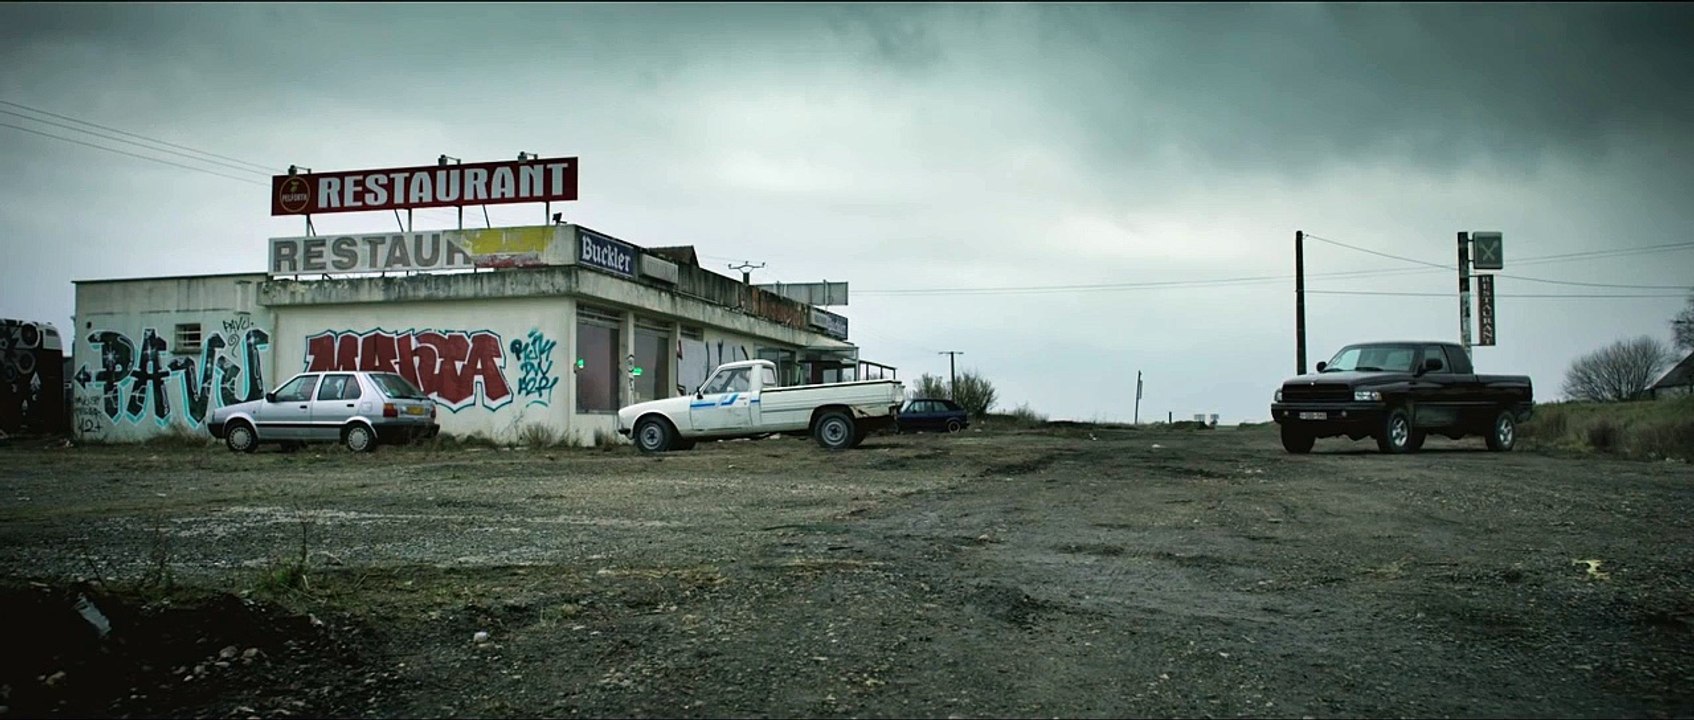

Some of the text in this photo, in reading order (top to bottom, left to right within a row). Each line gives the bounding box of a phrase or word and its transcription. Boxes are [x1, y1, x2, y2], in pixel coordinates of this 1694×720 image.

[317, 162, 569, 209] RESTAURANT
[582, 235, 631, 272] Buckler
[1482, 276, 1493, 344] RESTAURANT
